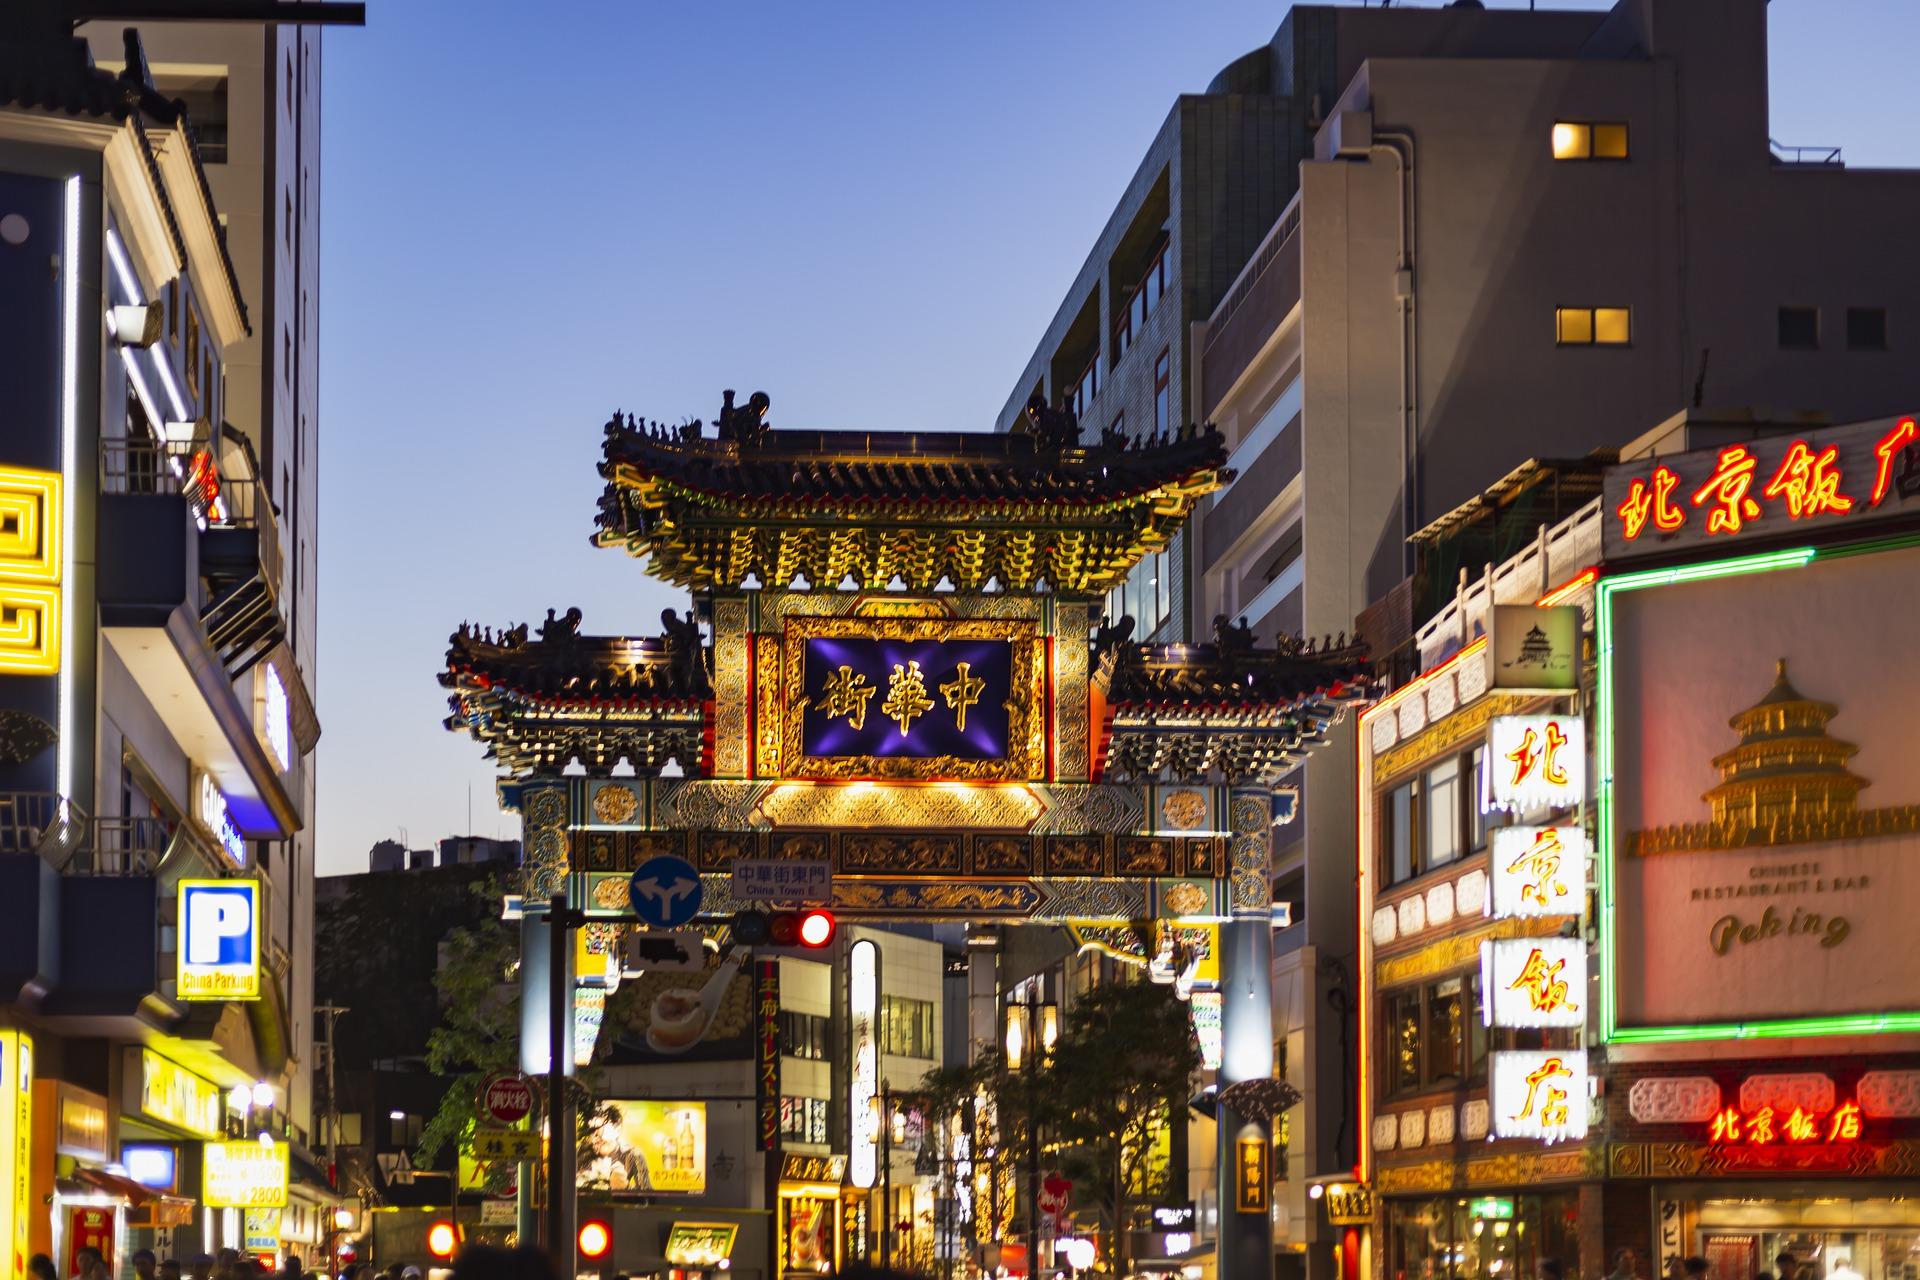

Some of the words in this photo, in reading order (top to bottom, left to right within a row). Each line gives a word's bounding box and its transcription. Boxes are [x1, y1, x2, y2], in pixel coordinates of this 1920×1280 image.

[738, 865, 825, 884] 中華街東門
[1749, 862, 1821, 879] CHINESE
[746, 885, 775, 896] China
[780, 886, 805, 896] Town
[1691, 880, 1808, 901] RESTAURANT
[1833, 875, 1871, 891] BAR
[189, 891, 250, 963] P
[1709, 905, 1851, 956] Peking
[183, 972, 212, 990] China
[214, 971, 254, 991] Parking
[758, 977, 780, 1141] 王府井レストラン
[490, 1091, 528, 1110] 消火栓
[1710, 1104, 1864, 1145] 北京飯店
